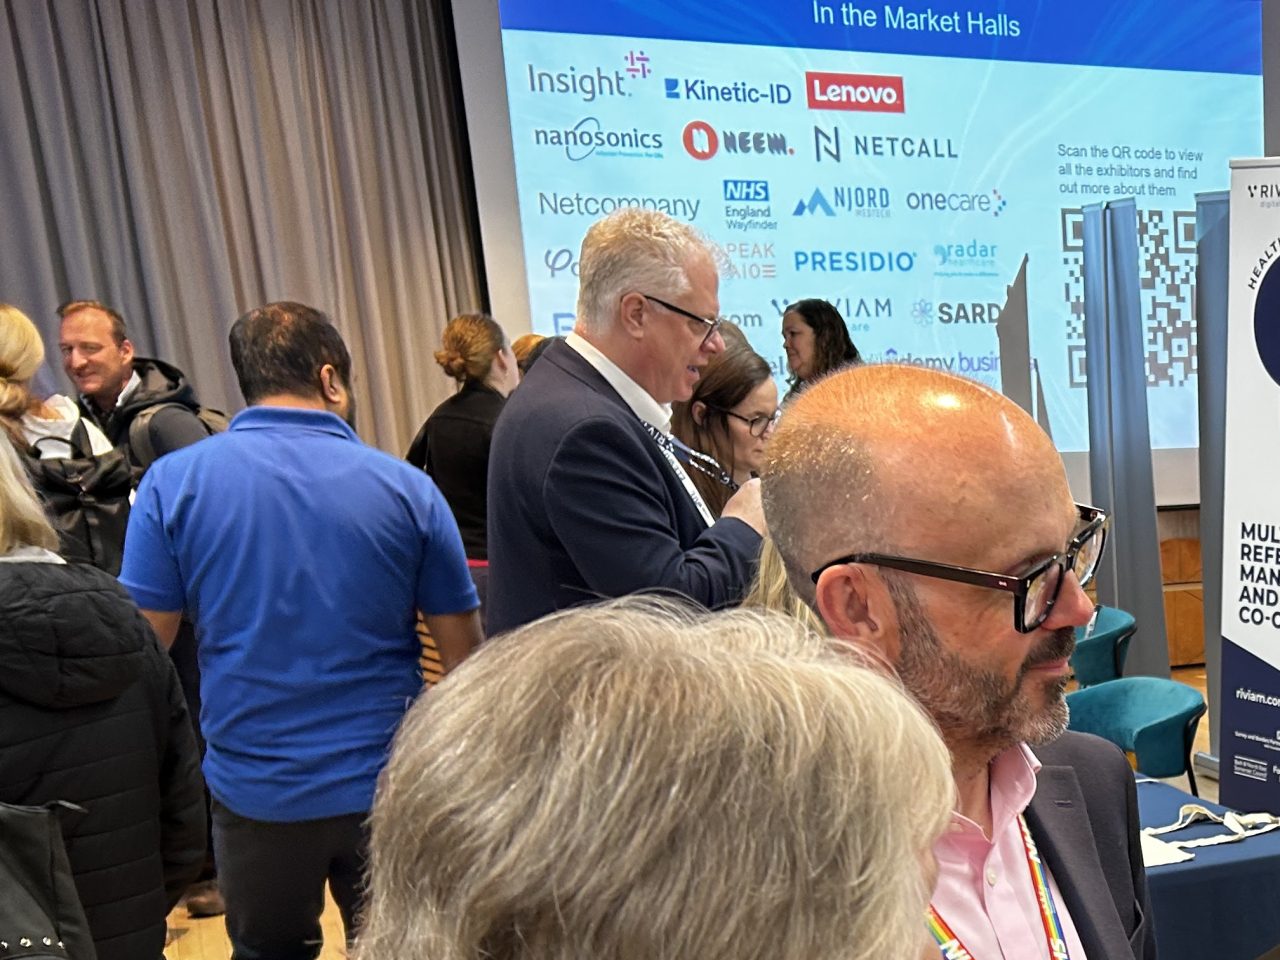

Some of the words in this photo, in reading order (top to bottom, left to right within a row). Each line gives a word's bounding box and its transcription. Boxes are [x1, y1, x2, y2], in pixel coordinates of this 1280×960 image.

[813, 0, 835, 24] In
[841, 3, 877, 27] the
[884, 5, 960, 33] Market
[967, 10, 1020, 36] Halls
[685, 79, 792, 104] Kinetic-ID
[813, 79, 897, 104] Lenovo
[535, 128, 663, 149] nanosonics
[854, 135, 958, 158] NETCALL
[1058, 144, 1087, 158] Scan
[1090, 145, 1109, 159] the
[1111, 146, 1132, 161] QR
[1134, 147, 1162, 160] code
[1165, 149, 1176, 161] to
[1178, 148, 1203, 162] view
[1058, 163, 1071, 176] all
[1075, 164, 1093, 177] the
[1096, 164, 1151, 178] exhibitors
[1154, 165, 1175, 179] and
[1177, 166, 1198, 180] find
[724, 181, 768, 200] NHS
[834, 186, 890, 211] NJORD
[906, 190, 991, 211] onecare
[1059, 183, 1077, 195] out
[1081, 184, 1110, 195] more
[1113, 183, 1144, 196] about
[1147, 184, 1176, 197] them
[539, 192, 700, 221] Netcompany
[725, 206, 771, 219] England
[726, 220, 778, 231] Wayfinder
[947, 239, 997, 257] radar
[795, 252, 914, 272] PRESIDIO
[1239, 586, 1278, 607] AND
